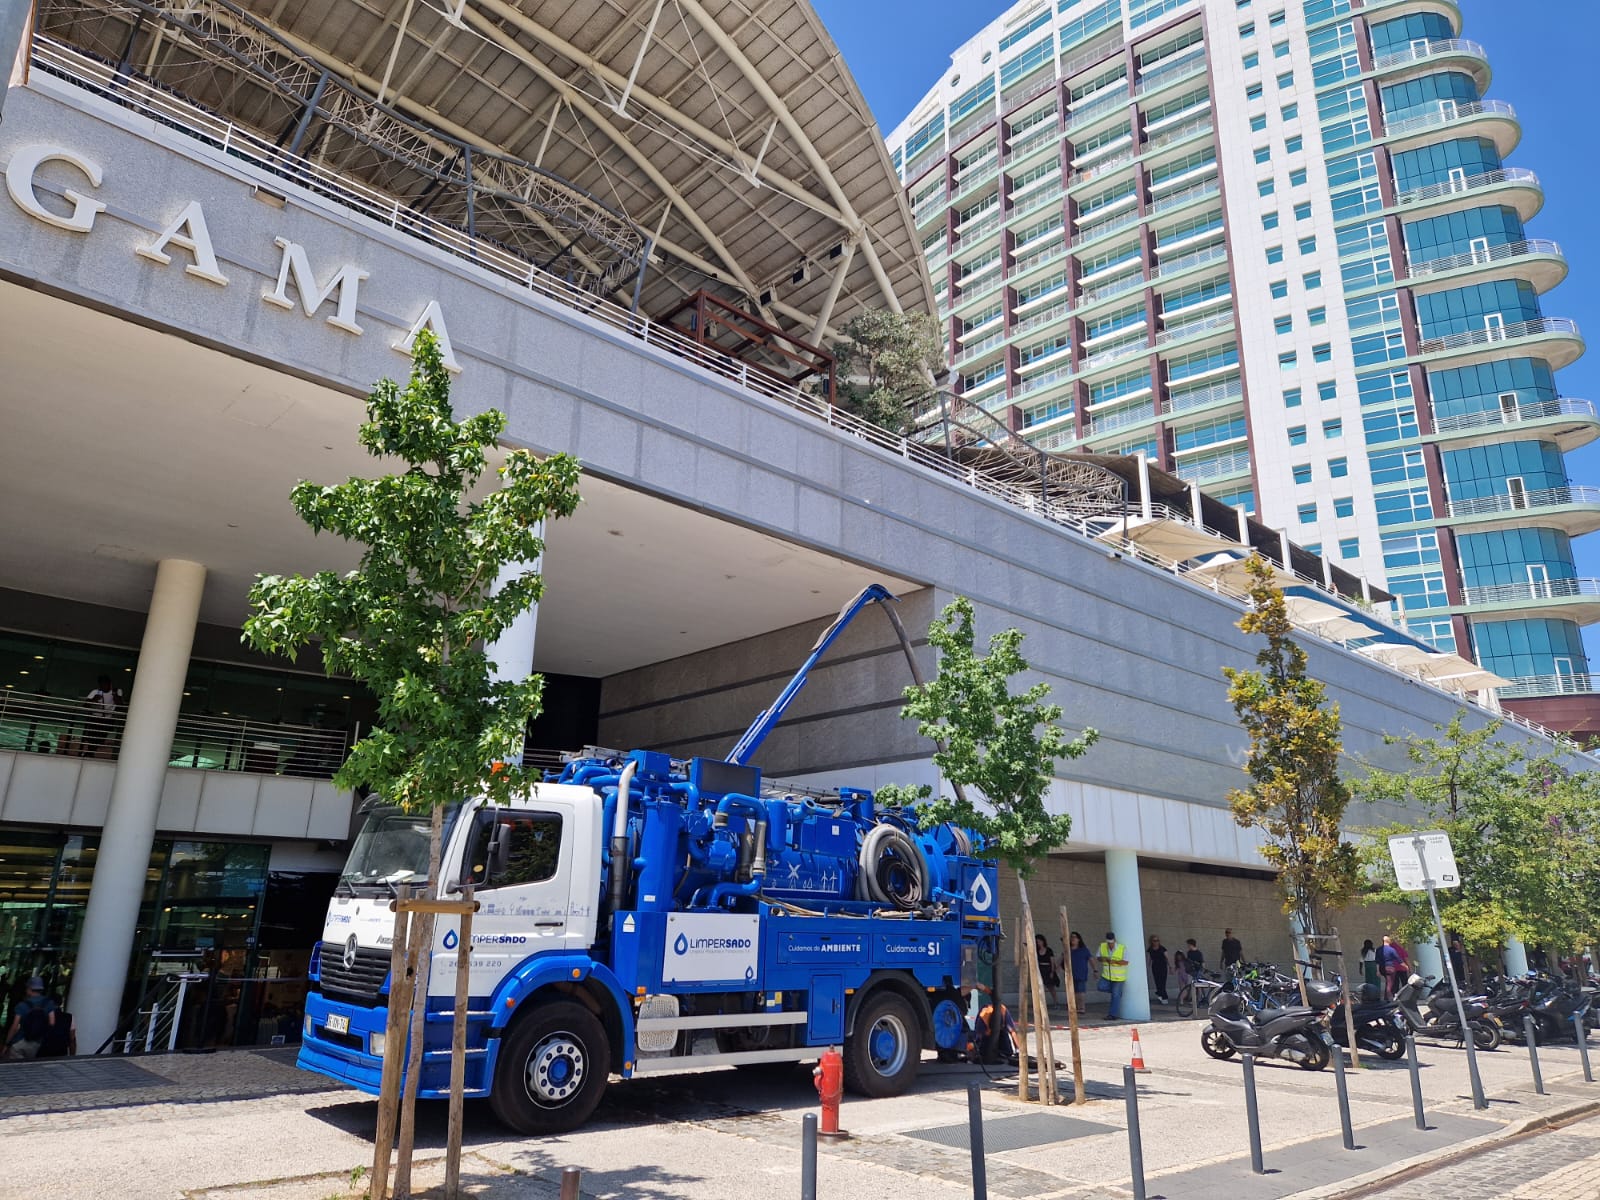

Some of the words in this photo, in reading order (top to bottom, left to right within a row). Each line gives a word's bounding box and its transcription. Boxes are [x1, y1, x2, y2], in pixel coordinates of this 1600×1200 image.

[5, 143, 463, 375] GAMA
[472, 935, 527, 944] MPERSADO
[820, 944, 861, 953] AMBIENTE
[885, 944, 917, 953] Cuidamos
[927, 942, 940, 956] SI
